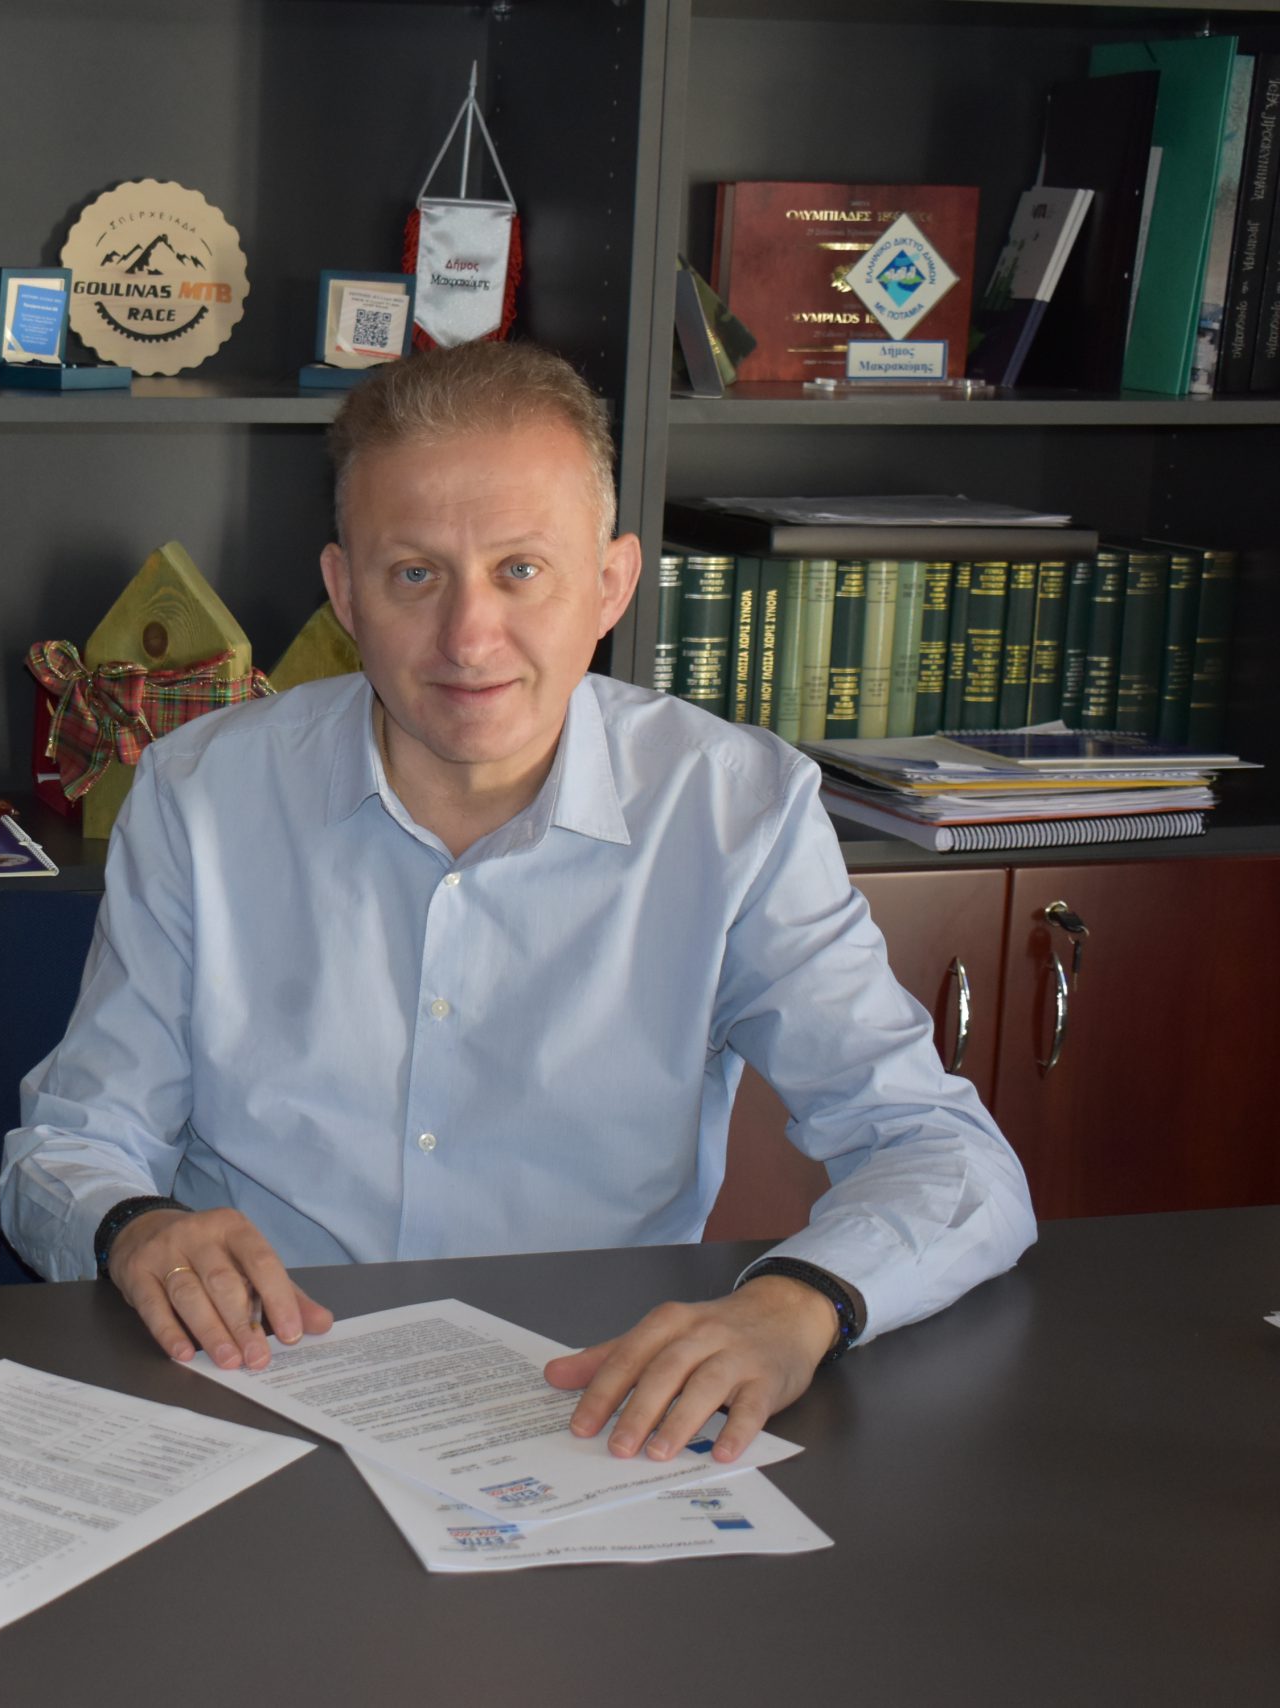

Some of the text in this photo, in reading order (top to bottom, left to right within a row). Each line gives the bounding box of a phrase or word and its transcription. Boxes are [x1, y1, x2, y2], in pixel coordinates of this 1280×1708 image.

[109, 210, 197, 234] ΣΠΕΡΧΕΙΑΔΑ
[785, 210, 872, 222] ΟΛΥΜΠΙΑΔΕΣ
[445, 258, 479, 272] Δήμος
[865, 237, 937, 285] ΕΛΛΗΝΙΚΟ ΔΙΚΤΥΟ ΔΗΜΩΝ
[74, 280, 172, 299] GOULINAS
[178, 281, 233, 304] MTB
[127, 307, 176, 322] RACE
[874, 302, 924, 320] ΜΕ ΠΟΤΑΜΙΑ
[879, 345, 916, 358] Δήμος
[858, 360, 934, 373] Μακρακώμης
[740, 590, 753, 622] ΣΥΝΟΡΑ
[765, 588, 778, 622] ΣΥΝΟΡΑ
[739, 625, 750, 649] ΧΩΡΙΣ
[763, 624, 775, 648] ΧΩΡΙΣ
[736, 651, 749, 680] ΓΛΩΣΣΑ
[761, 651, 774, 680] ΓΛΩΣΣΑ
[736, 682, 747, 701] ΜΟΥ
[761, 682, 772, 701] ΜΟΥ
